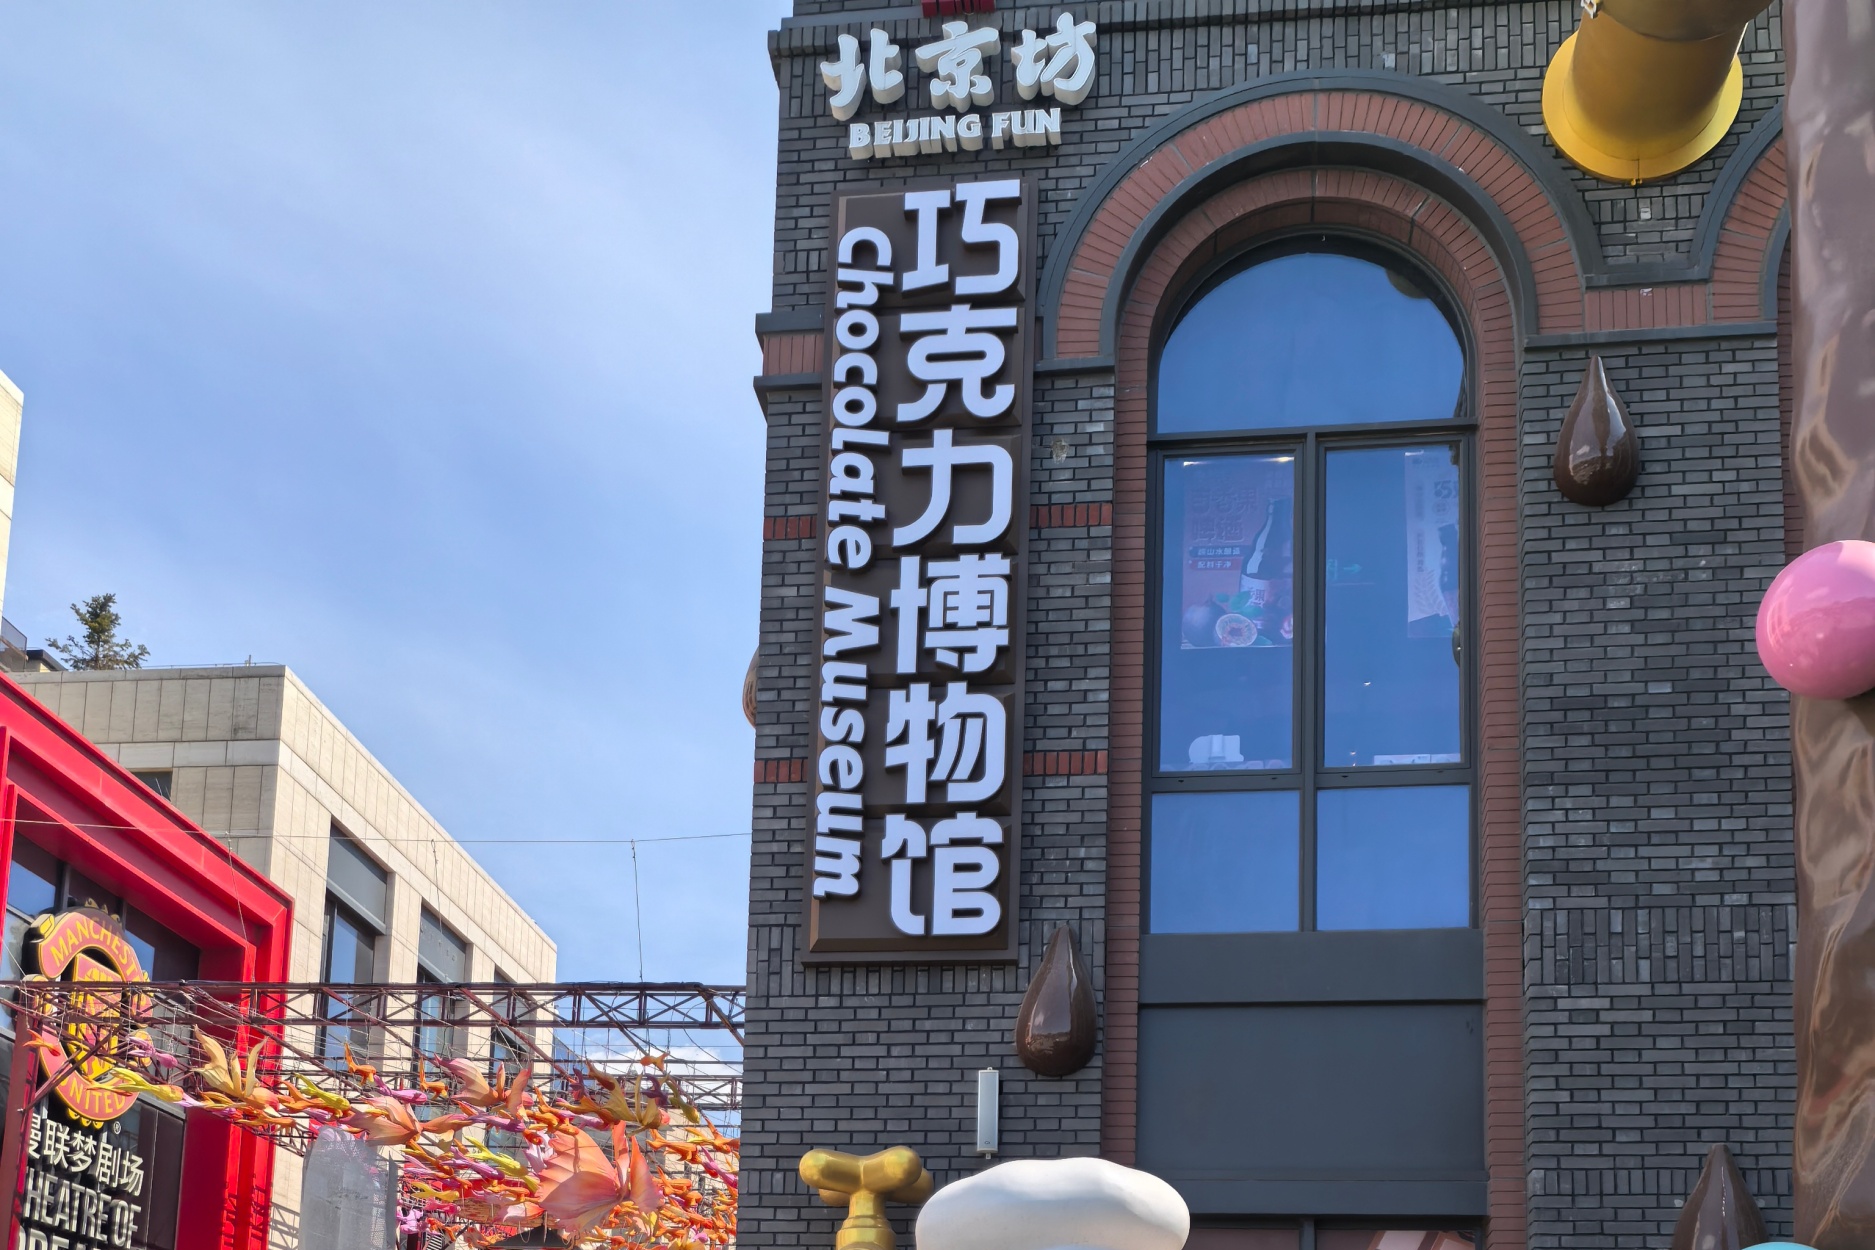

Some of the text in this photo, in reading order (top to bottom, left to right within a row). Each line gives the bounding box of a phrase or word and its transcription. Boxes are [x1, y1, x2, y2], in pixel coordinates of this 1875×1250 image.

[820, 12, 1097, 119] 北京坊
[849, 108, 1061, 158] BEIJING FUN
[813, 226, 893, 898] Chocolate Museum
[880, 179, 1021, 936] 巧克力博物馆
[1197, 560, 1232, 569] 配料干净
[23, 1167, 141, 1249] HEATRE OF
